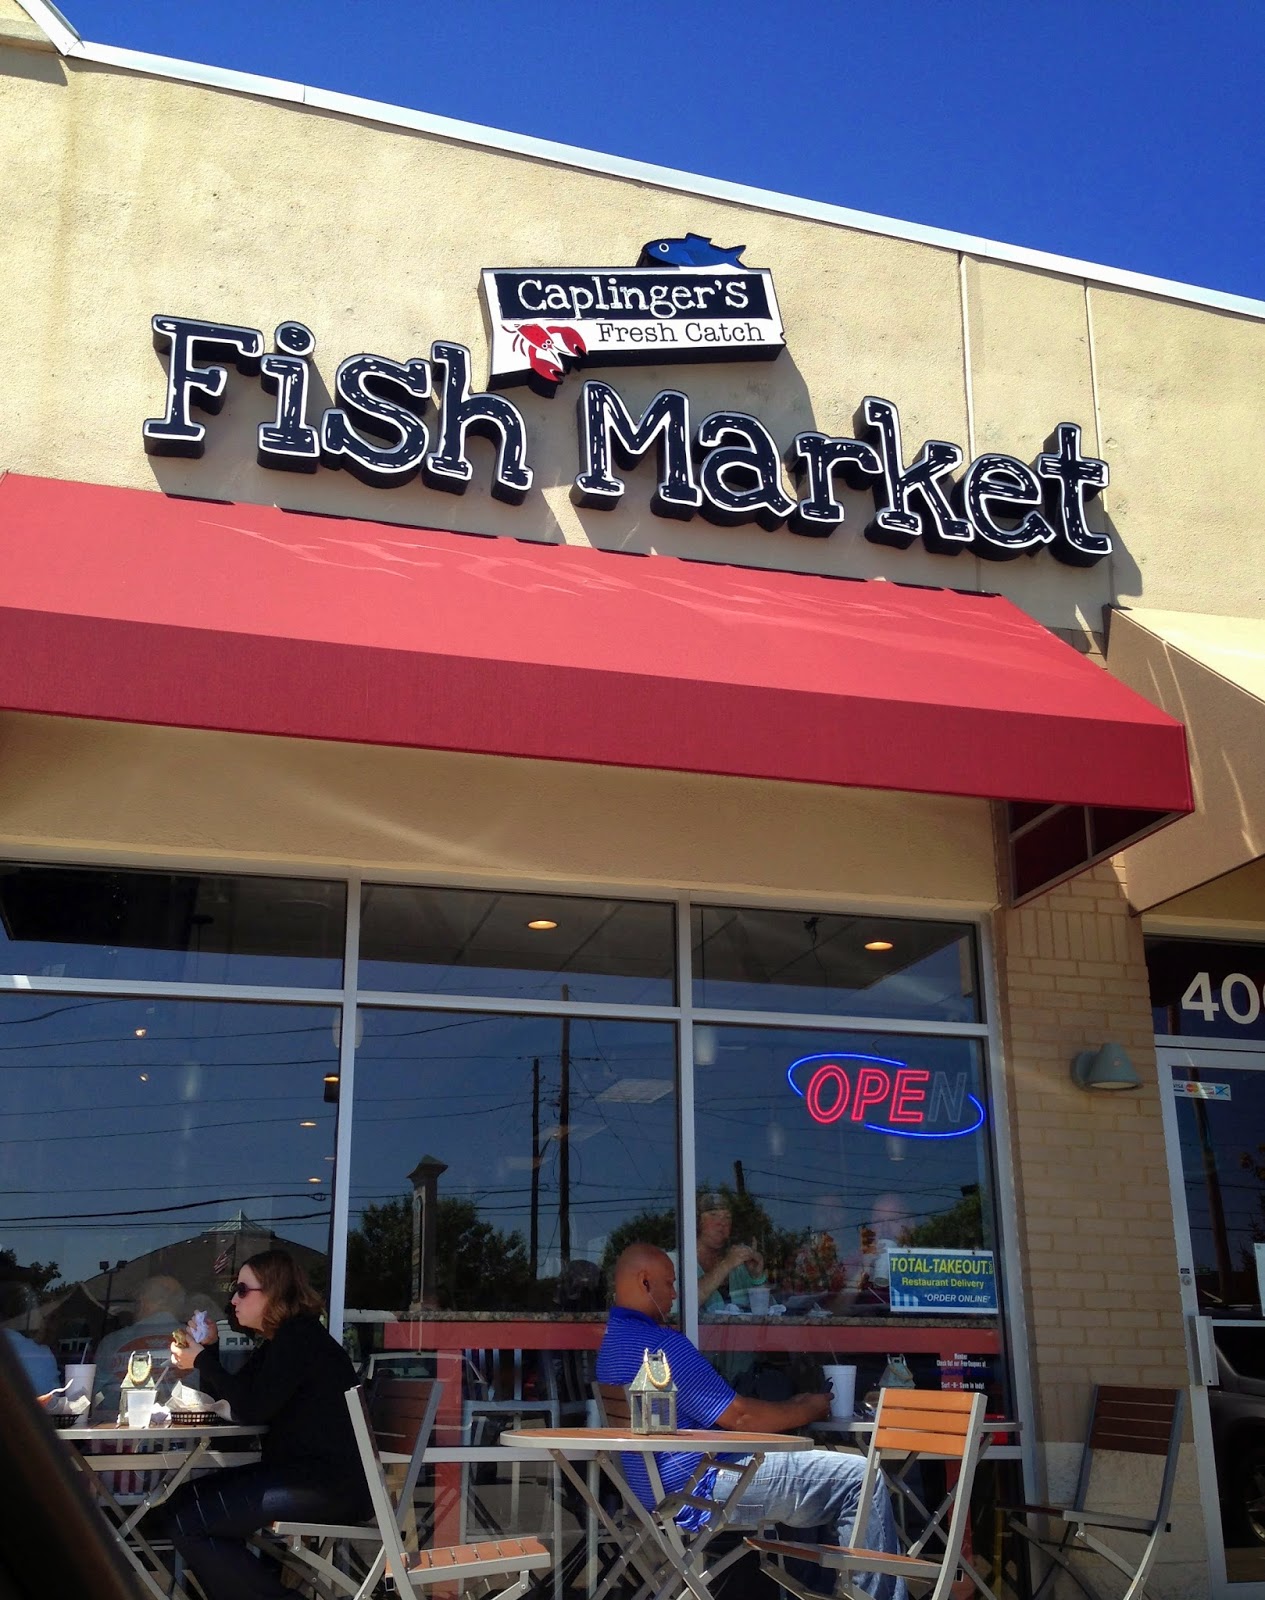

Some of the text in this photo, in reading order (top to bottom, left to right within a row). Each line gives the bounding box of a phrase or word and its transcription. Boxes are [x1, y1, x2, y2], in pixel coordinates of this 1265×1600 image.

[517, 276, 749, 319] Caplinger's
[596, 322, 765, 342] Fresh Catch
[143, 313, 1114, 557] Fish Market
[1181, 972, 1265, 1025] 40
[807, 1064, 968, 1124] OPEN
[901, 1277, 985, 1289] Restaurant Delivery
